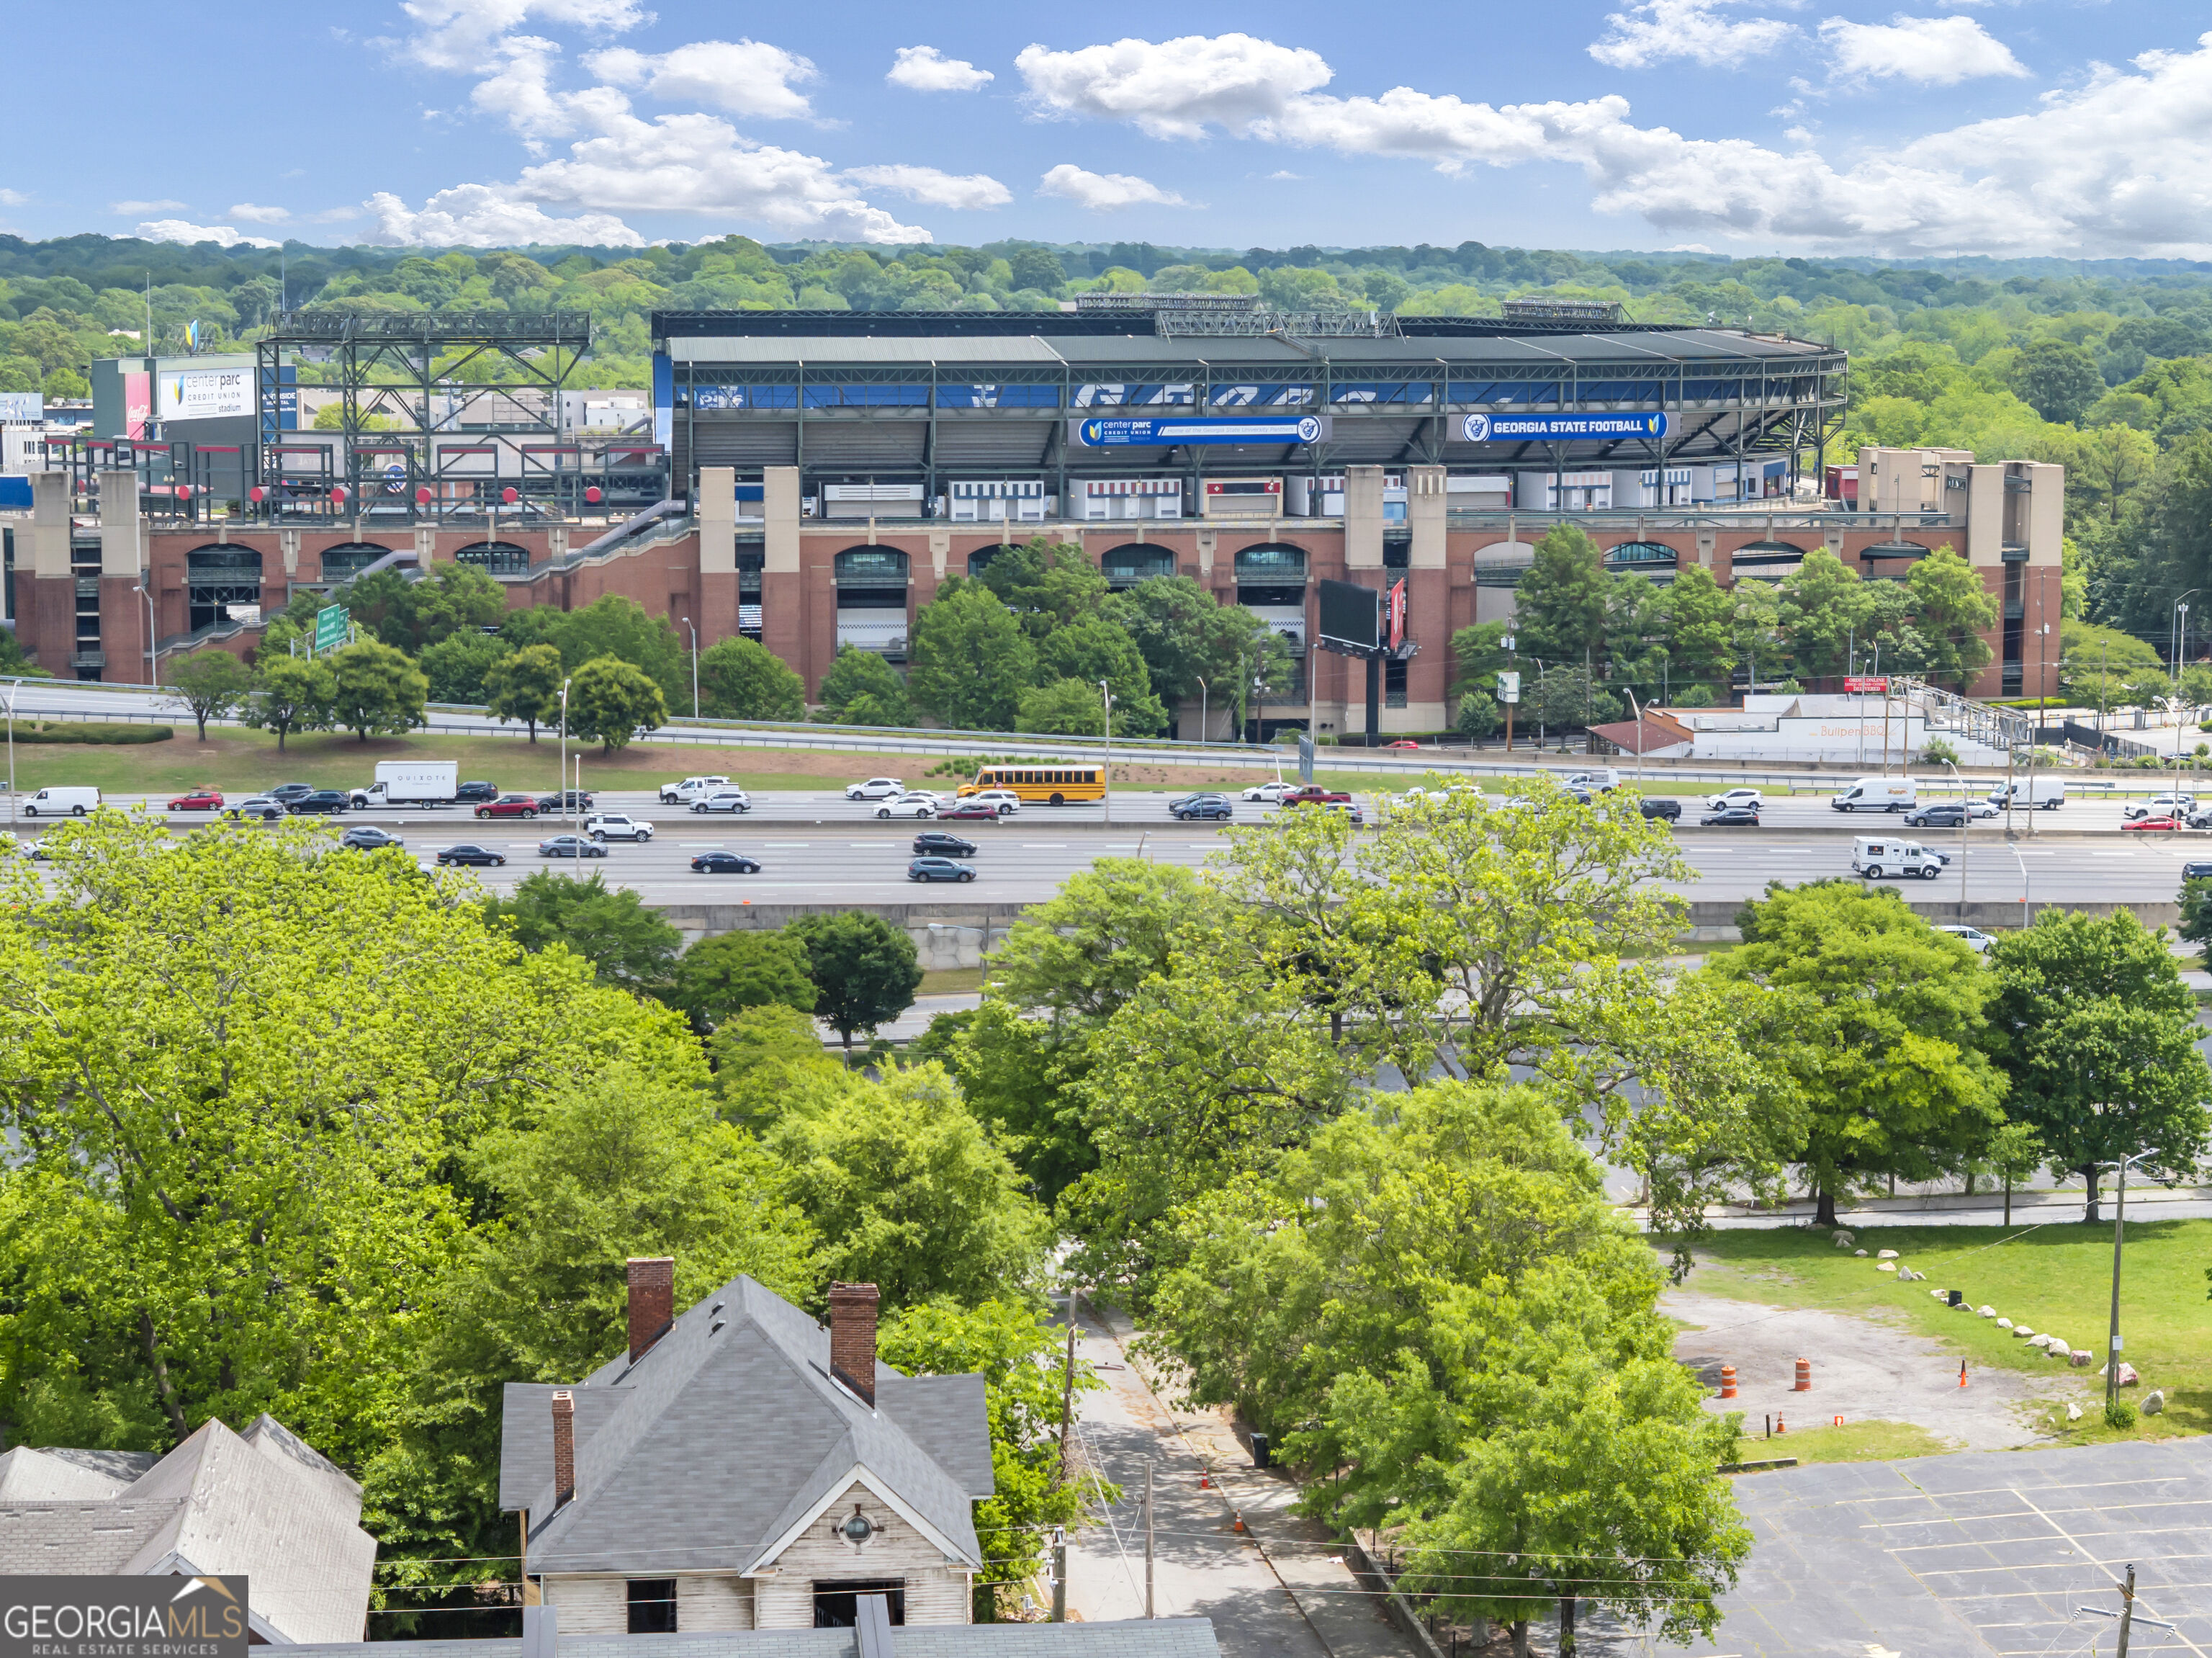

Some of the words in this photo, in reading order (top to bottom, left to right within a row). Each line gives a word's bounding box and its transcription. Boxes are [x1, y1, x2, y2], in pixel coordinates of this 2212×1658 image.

[186, 374, 219, 388] center
[220, 374, 240, 390] parc
[218, 391, 240, 400] UNION
[218, 404, 241, 413] stadium
[1132, 421, 1151, 430] parc
[1493, 421, 1548, 434] GEORGIA
[1550, 421, 1588, 433] STATE
[1588, 420, 1643, 432] FOOTBALL
[1820, 725, 1861, 738] Bullpen
[1863, 725, 1885, 736] BBQ
